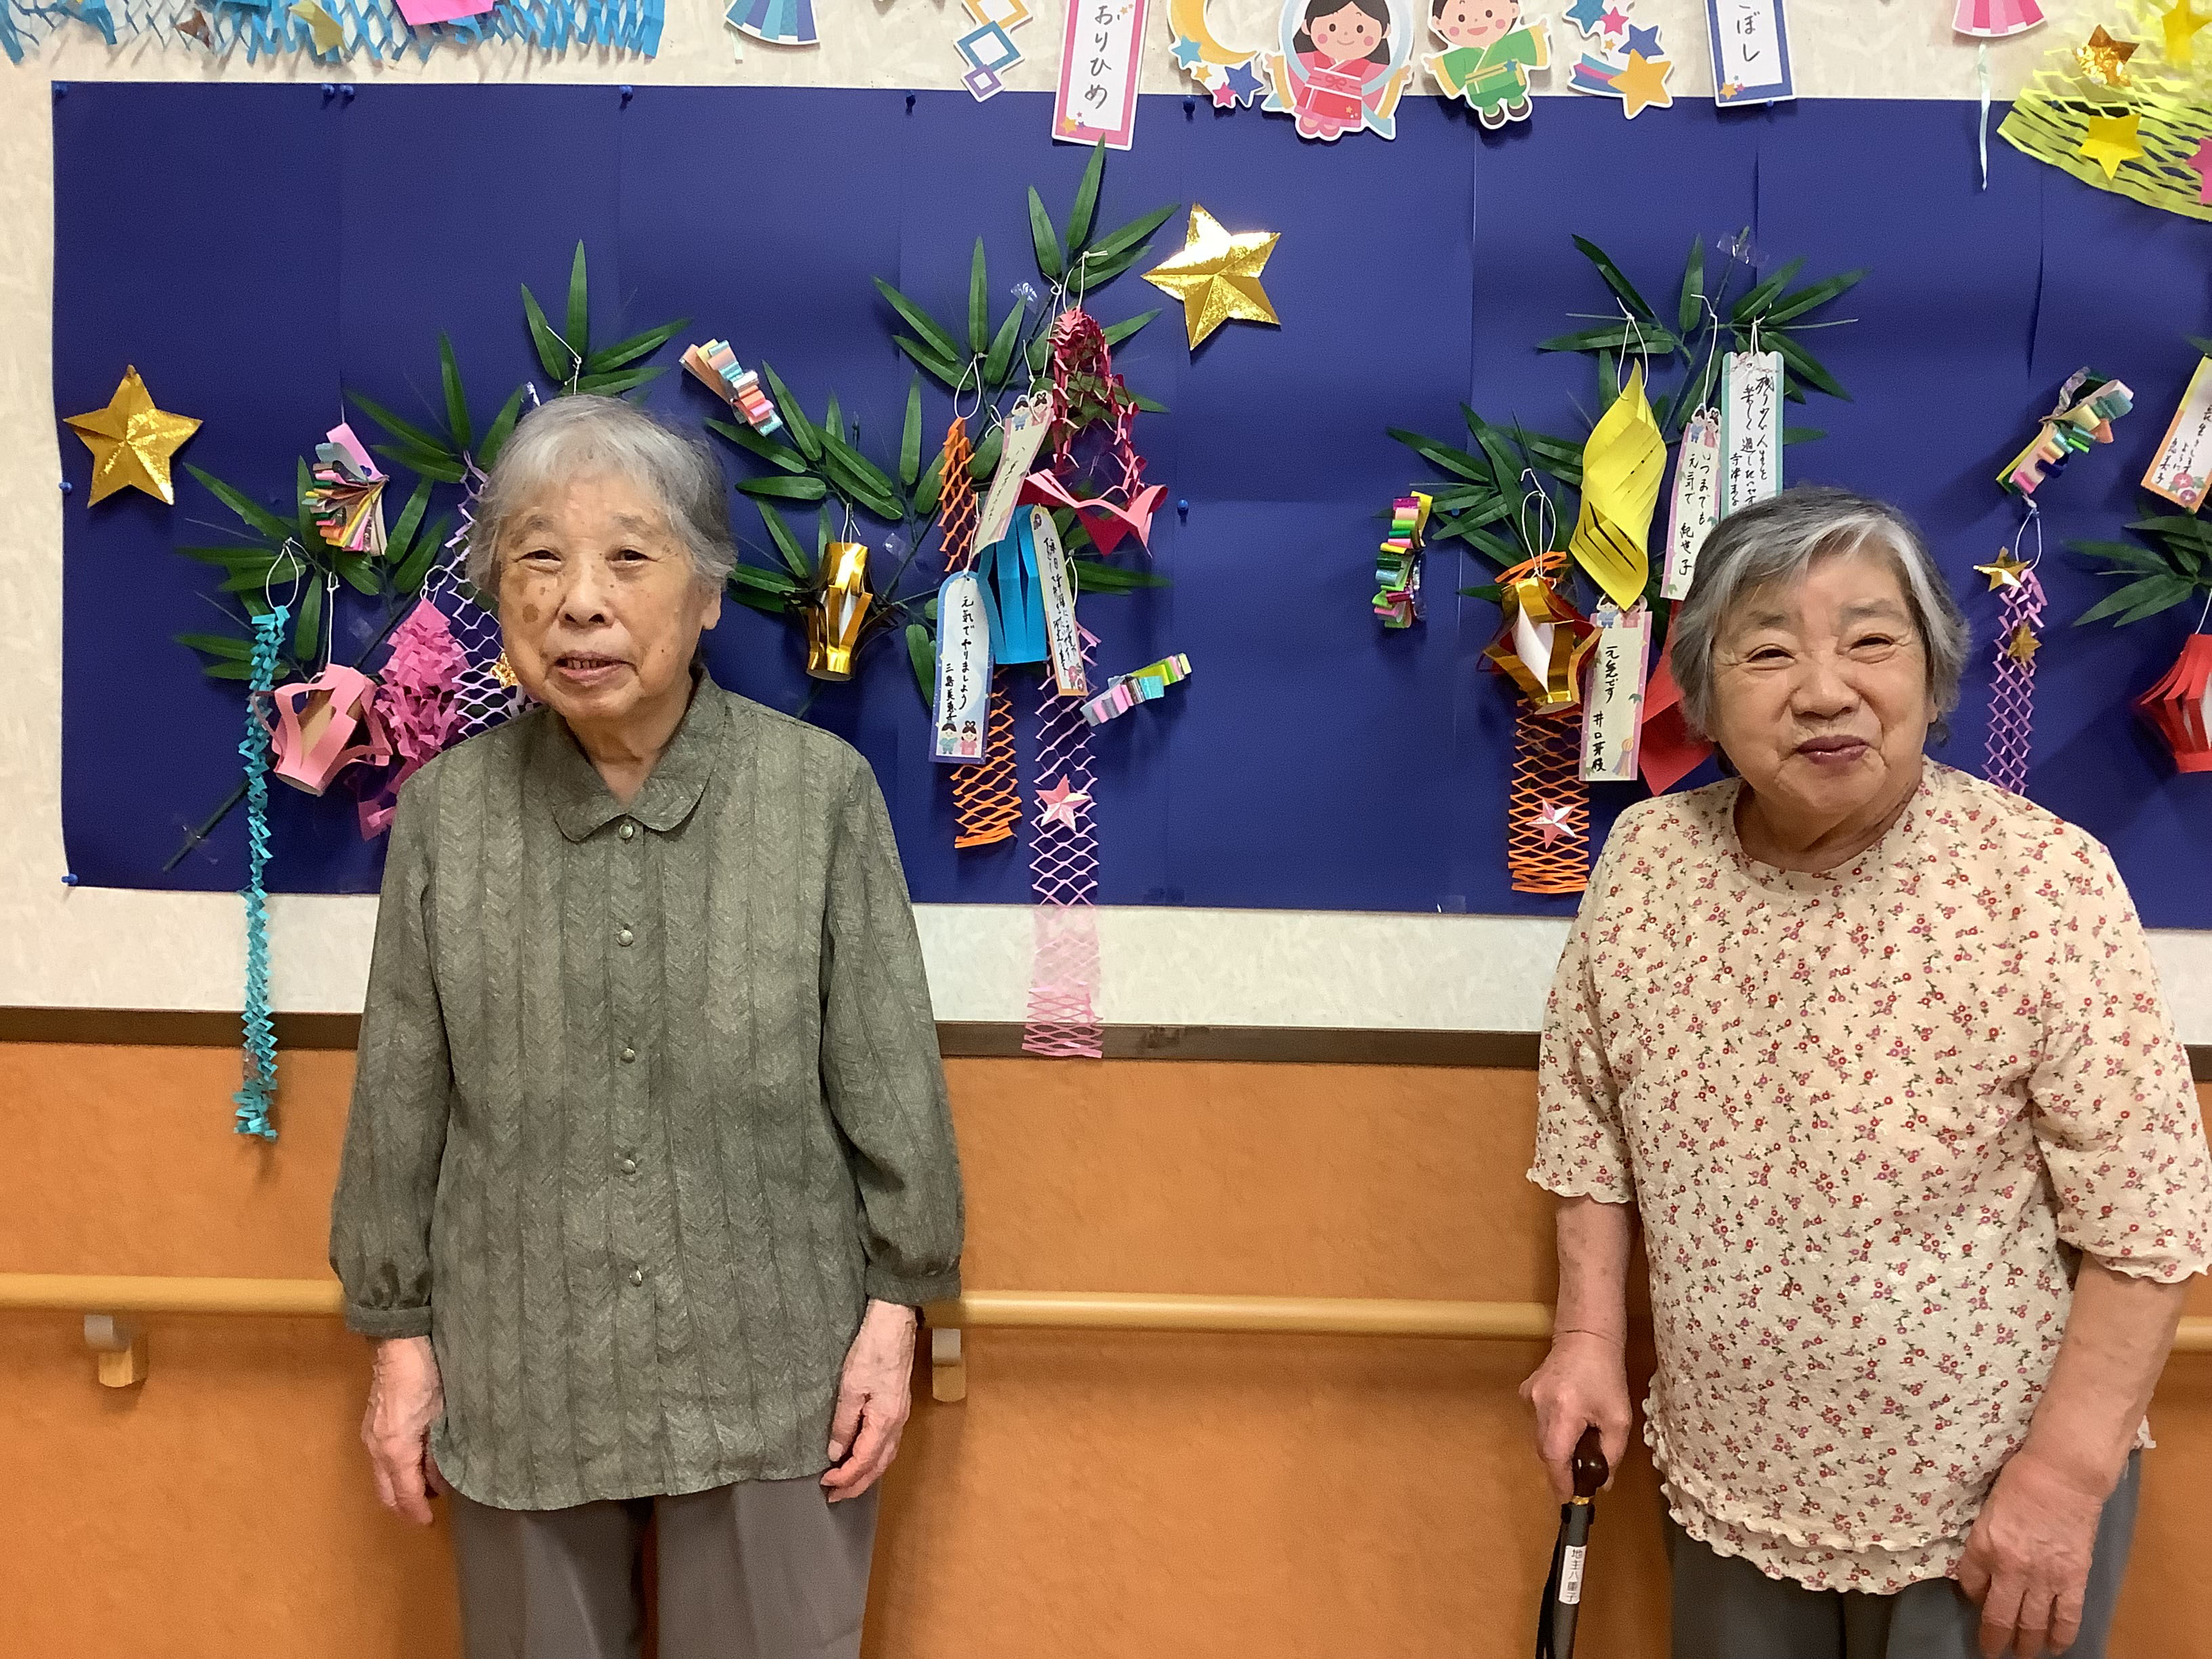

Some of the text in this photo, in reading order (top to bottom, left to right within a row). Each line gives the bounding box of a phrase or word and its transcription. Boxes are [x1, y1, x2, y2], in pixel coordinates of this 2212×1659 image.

[1084, 5, 1120, 109] おりひめ
[1698, 451, 1711, 525] いつまでも
[1605, 646, 1620, 704] 元気です
